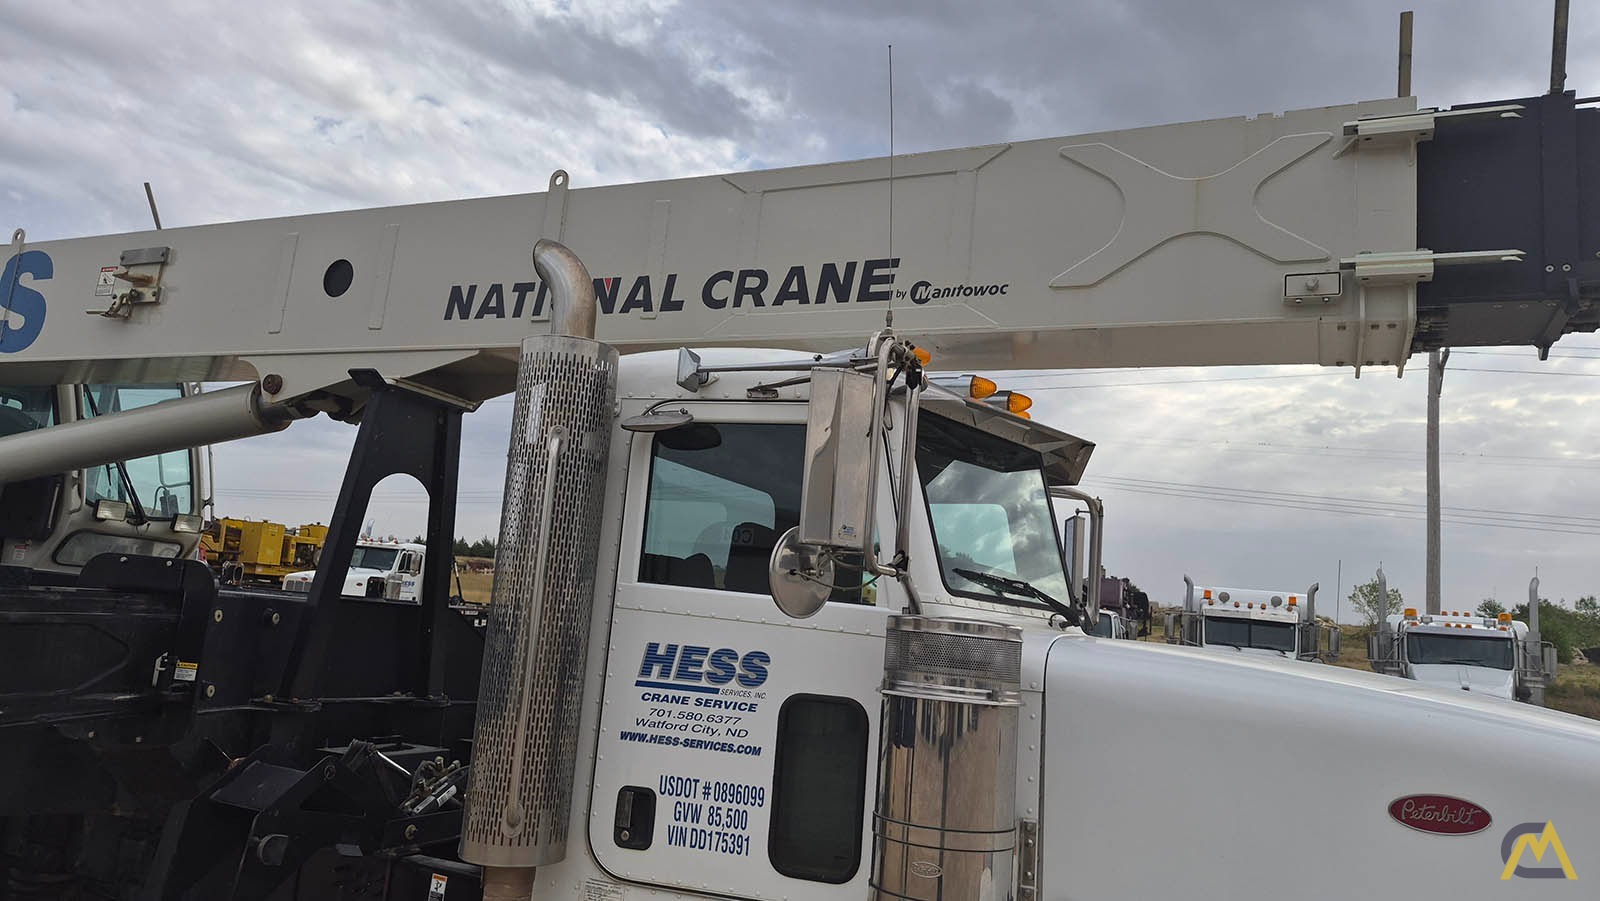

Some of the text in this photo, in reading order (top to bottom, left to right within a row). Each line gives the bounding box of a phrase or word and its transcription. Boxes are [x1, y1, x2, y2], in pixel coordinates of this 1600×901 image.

[443, 257, 900, 320] NATINAL CRANE
[895, 280, 1009, 304] by Manitowoc
[637, 642, 771, 689] HESS
[641, 692, 758, 713] CRANE SERVICE
[635, 717, 749, 739] Watford City, ND
[649, 708, 742, 726] 701.580.6377
[620, 731, 762, 756] WWW.HESS-SERVICES.COM
[659, 775, 765, 808] USDOT # 0896099
[673, 801, 748, 832] GVW 85,500
[1401, 799, 1482, 824] Peterbilt
[667, 825, 750, 857] VIN DD175391
